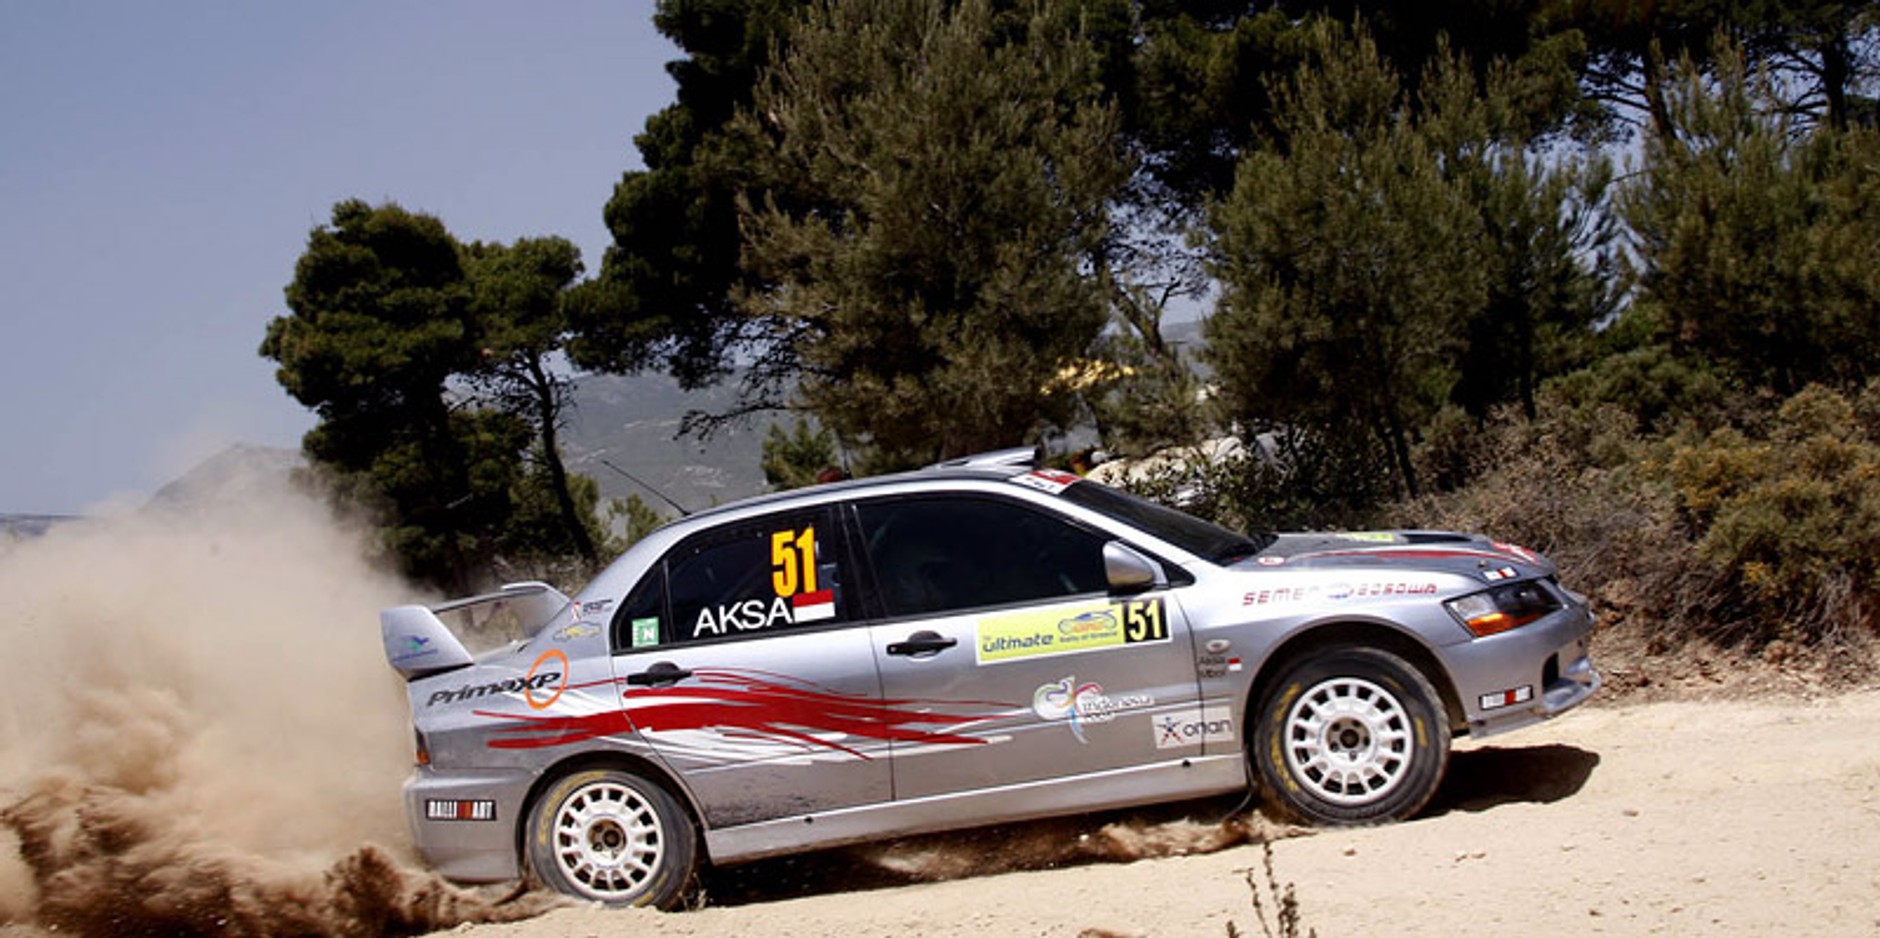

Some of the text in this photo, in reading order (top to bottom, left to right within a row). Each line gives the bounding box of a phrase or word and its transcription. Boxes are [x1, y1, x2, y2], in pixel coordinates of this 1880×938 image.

[772, 526, 817, 597] 51
[643, 628, 655, 641] N
[693, 597, 794, 637] AKSA
[1127, 599, 1162, 641] 51
[982, 632, 1054, 652] ultimate
